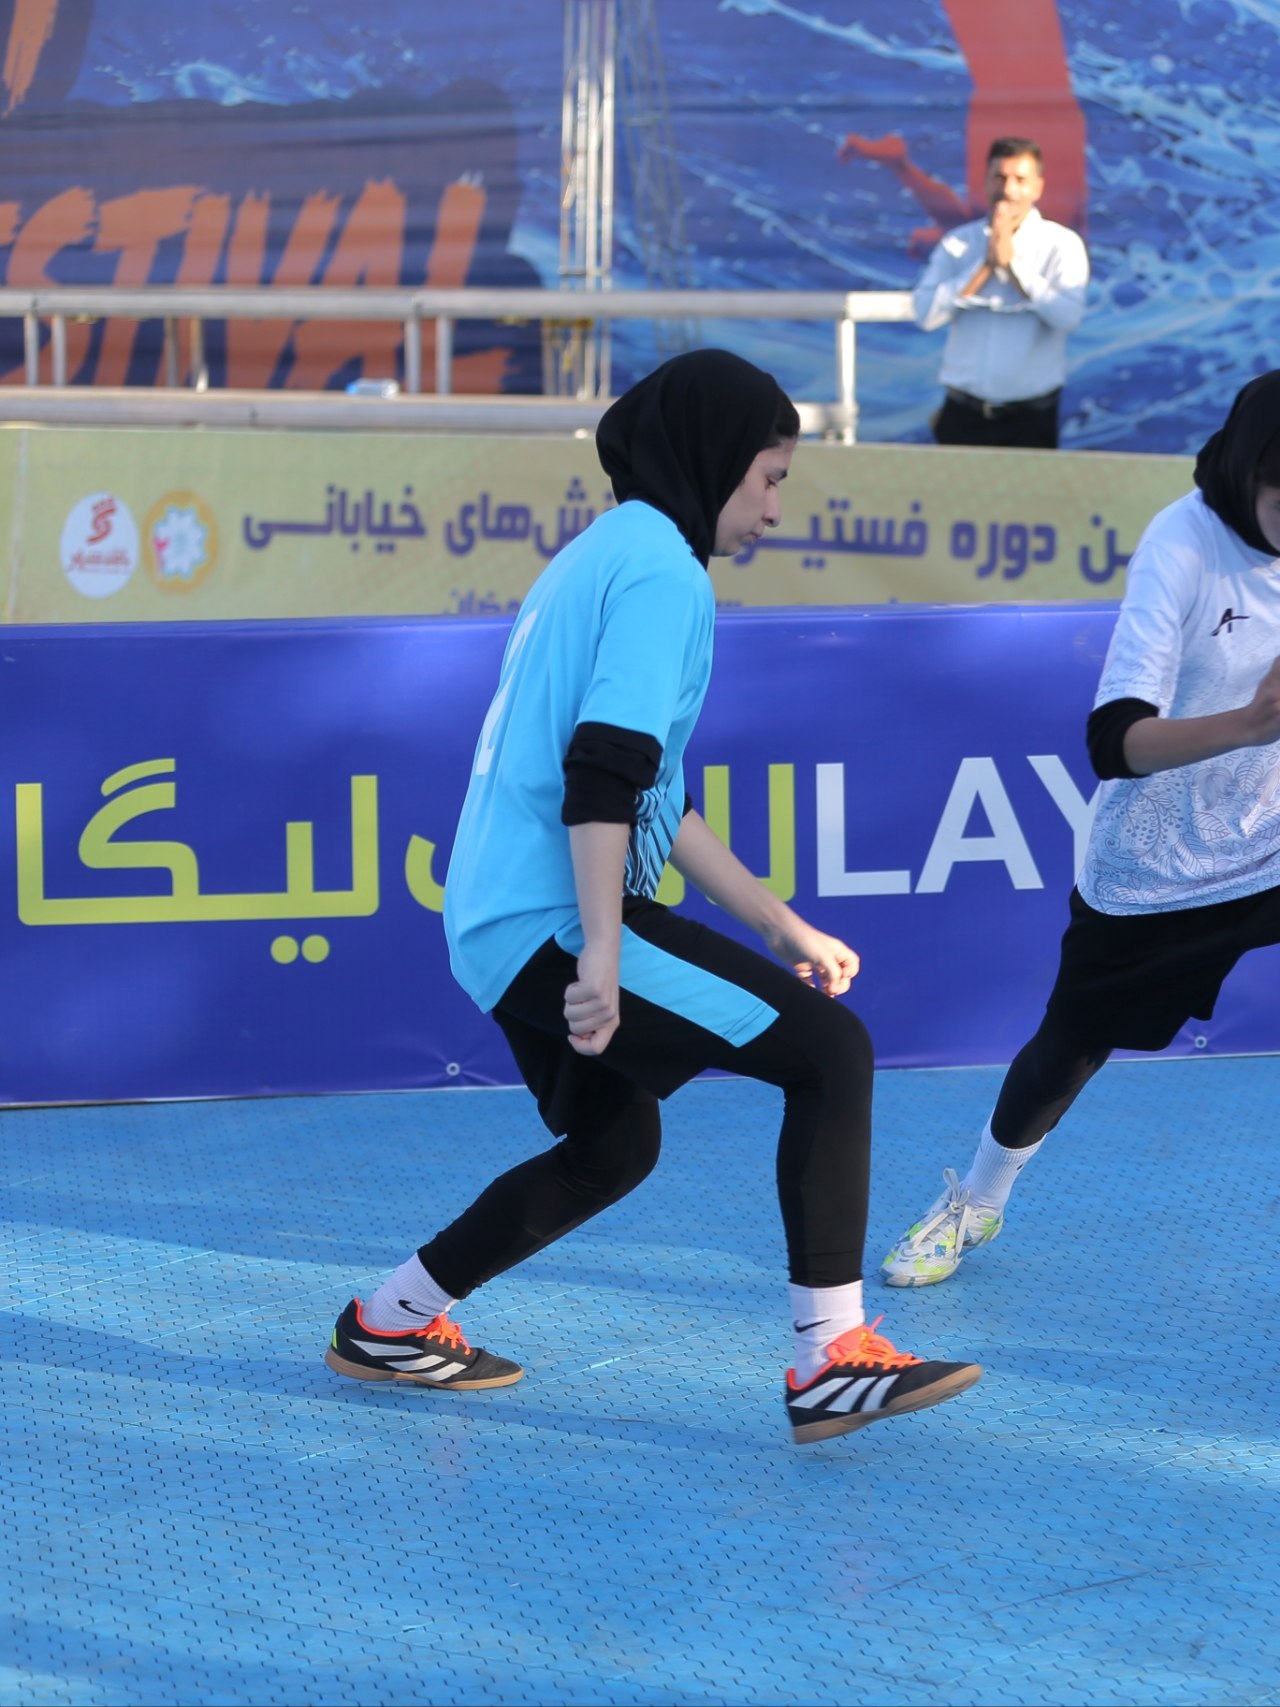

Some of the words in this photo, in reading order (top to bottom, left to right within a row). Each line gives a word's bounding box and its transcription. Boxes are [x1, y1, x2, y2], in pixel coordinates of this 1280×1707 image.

[242, 483, 428, 553] خیابانی
[948, 521, 1057, 581] دوره
[16, 757, 379, 965] لیگا
